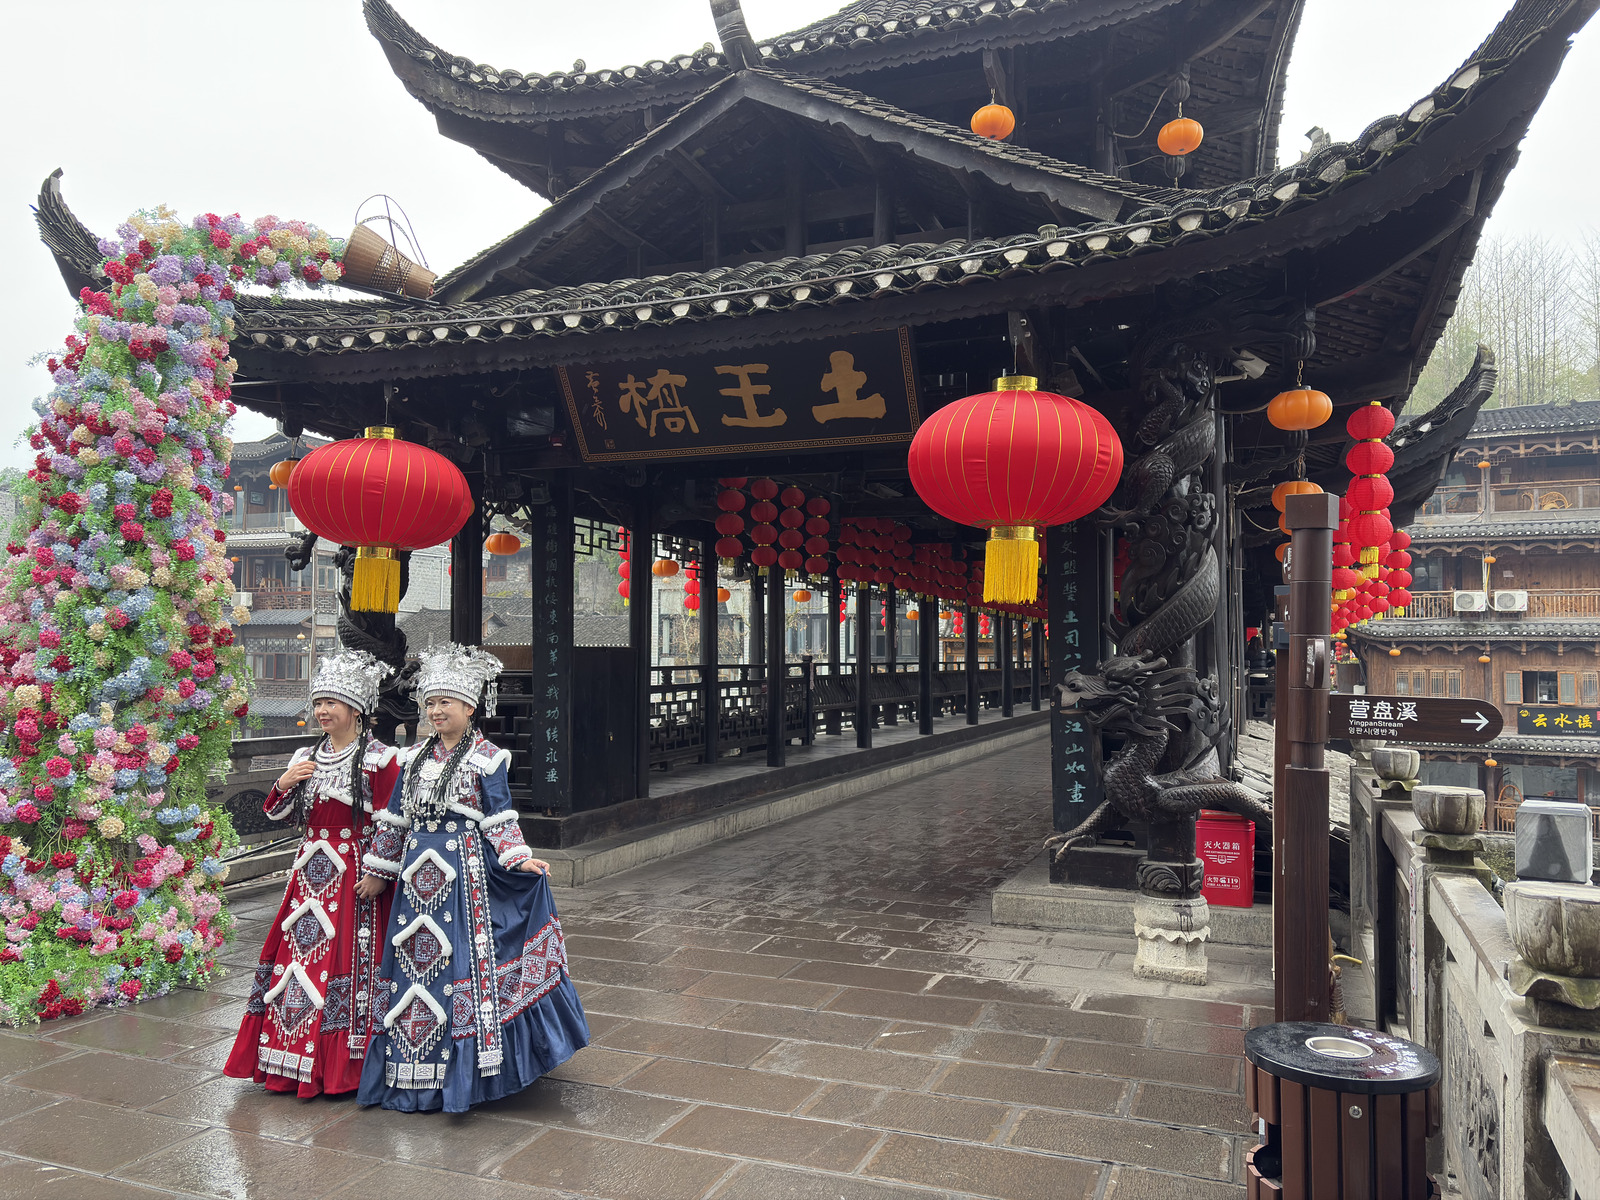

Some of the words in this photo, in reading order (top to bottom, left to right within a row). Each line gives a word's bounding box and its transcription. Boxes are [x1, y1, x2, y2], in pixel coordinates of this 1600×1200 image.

[1349, 699, 1418, 721] 营盘溪
[1532, 712, 1593, 729] 云水谣
[1204, 841, 1240, 850] 灭火器箱
